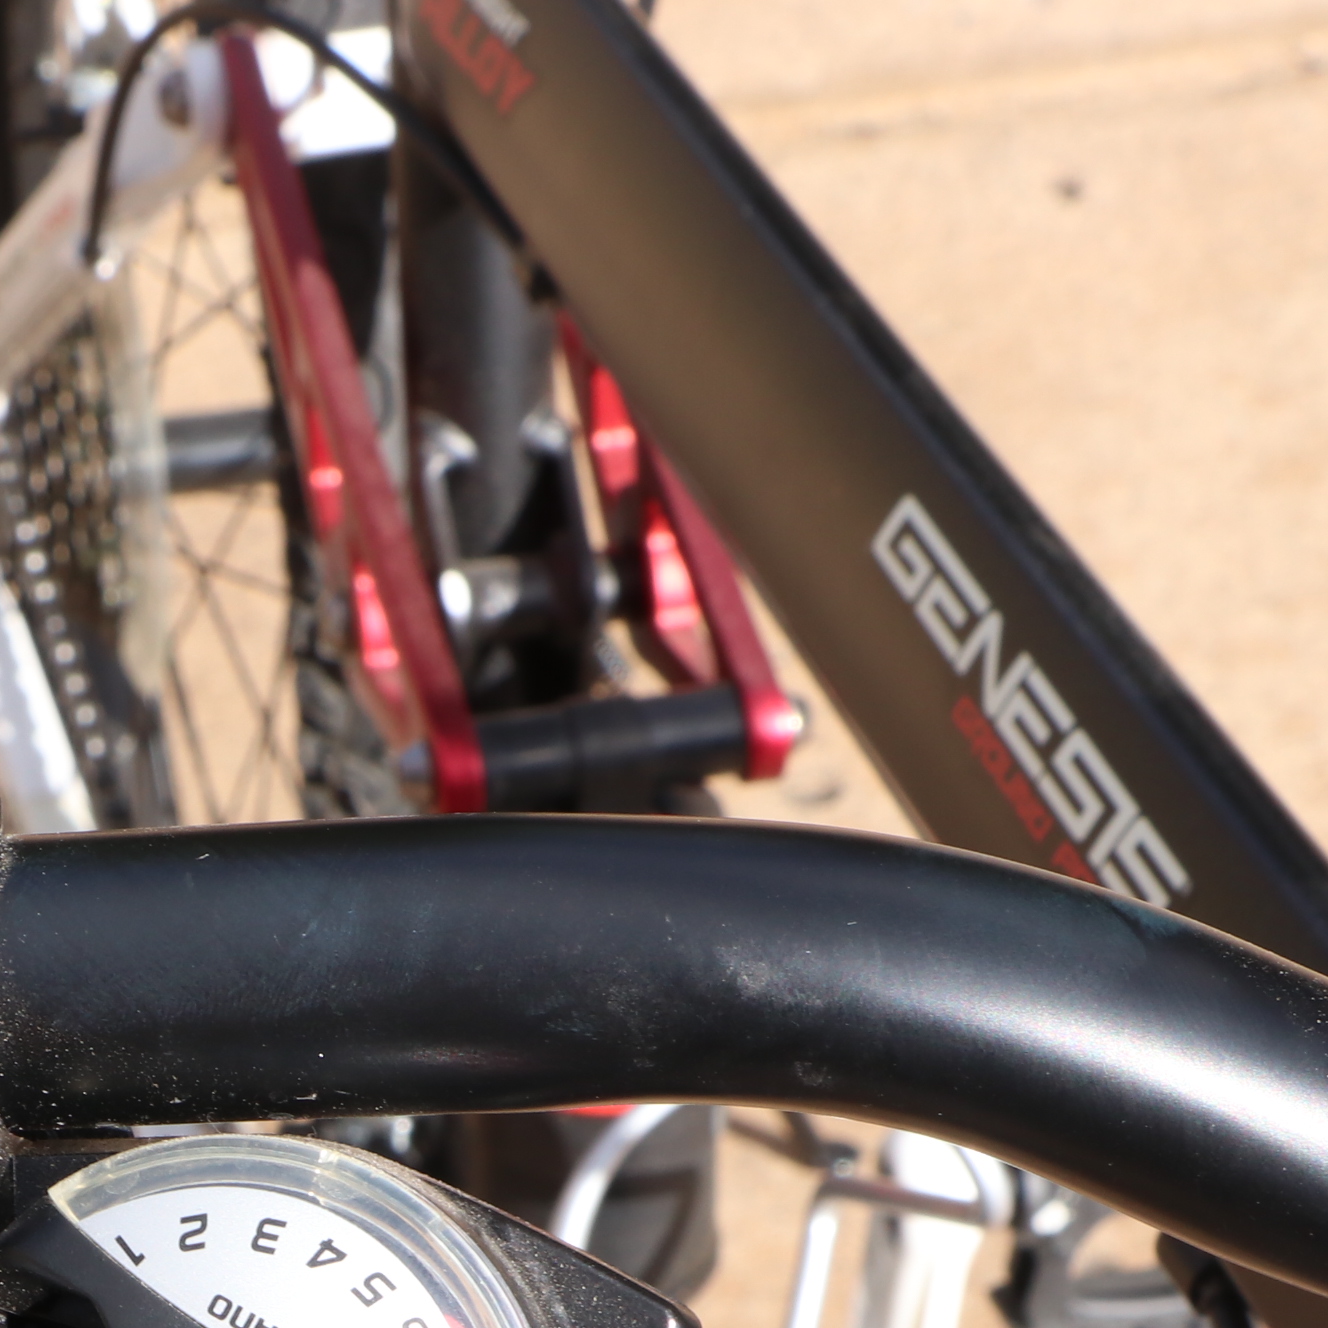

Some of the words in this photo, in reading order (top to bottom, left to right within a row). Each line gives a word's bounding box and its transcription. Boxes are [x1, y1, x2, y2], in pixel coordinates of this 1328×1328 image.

[871, 494, 1193, 910] GENESIS
[114, 1234, 146, 1268] 1
[177, 1212, 209, 1252] 2
[249, 1216, 289, 1255] 3
[305, 1237, 348, 1270] 4
[350, 1270, 398, 1308] 5
